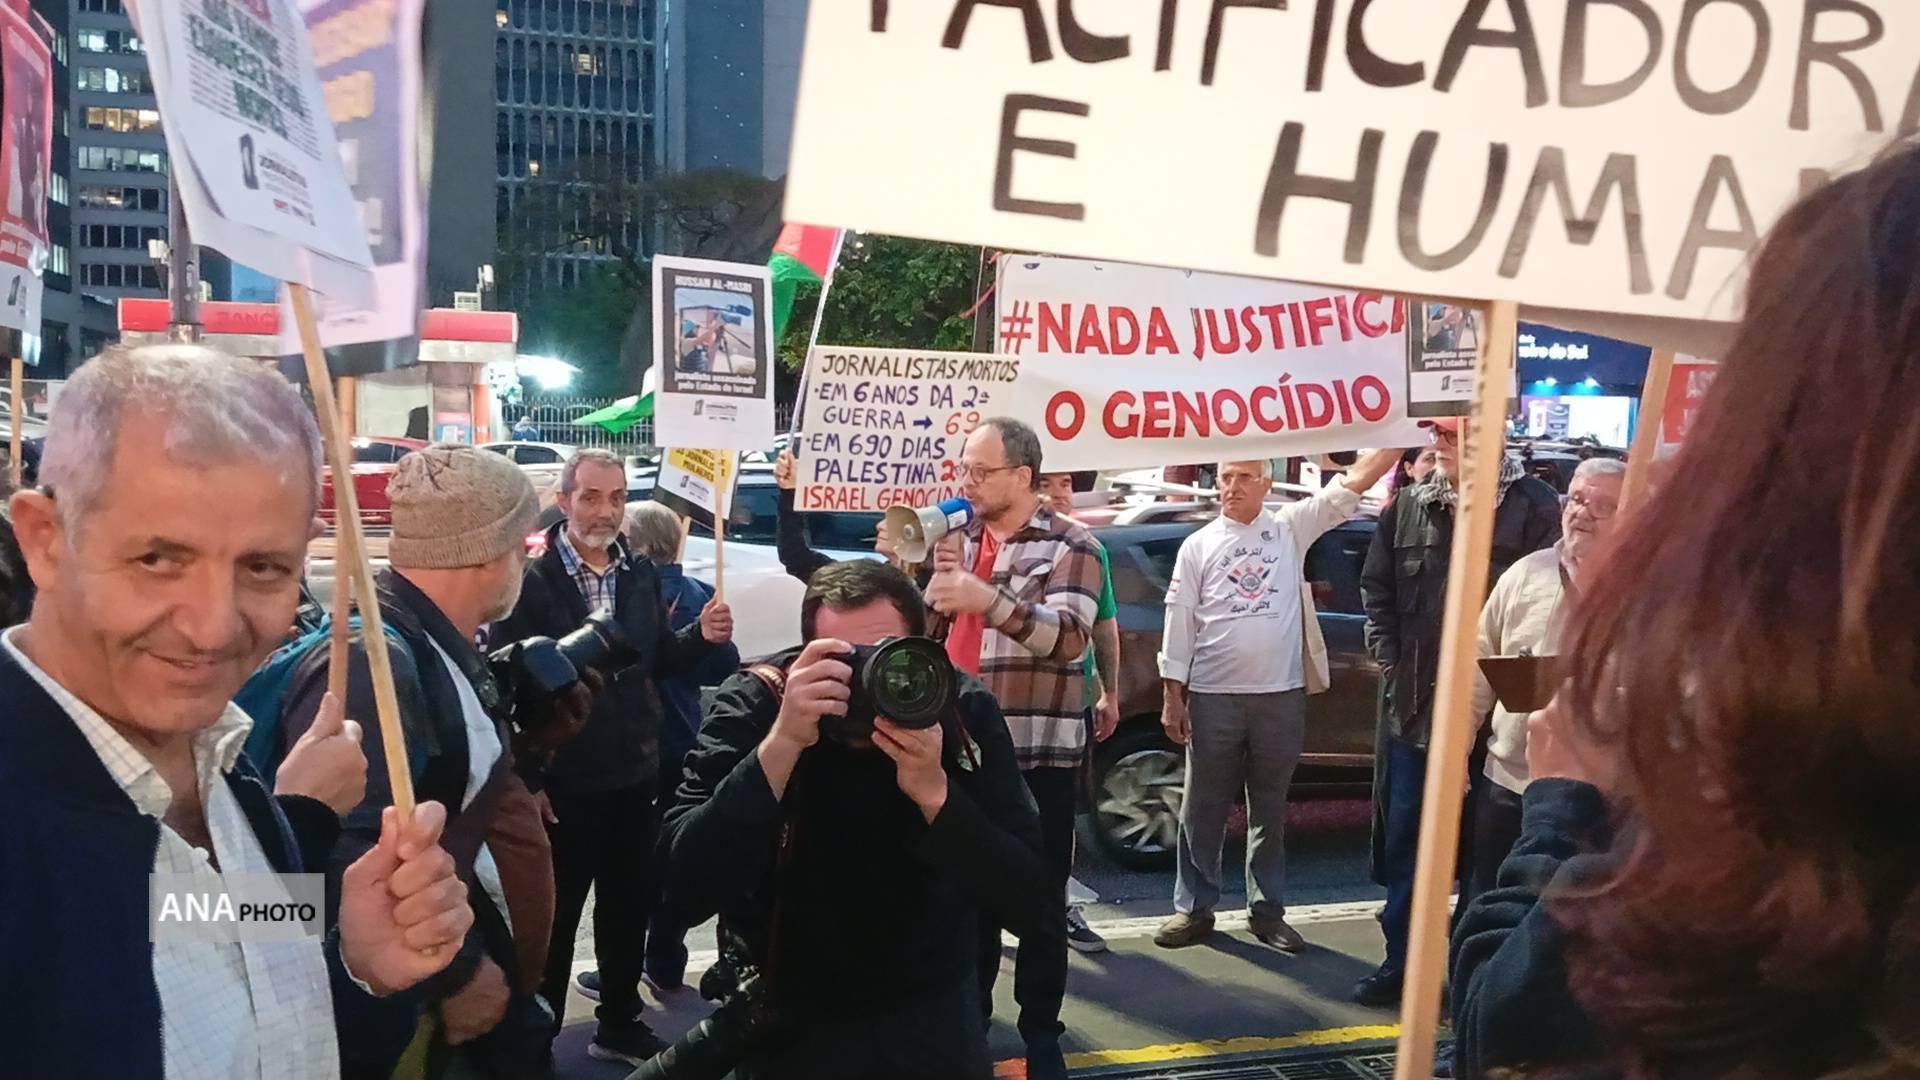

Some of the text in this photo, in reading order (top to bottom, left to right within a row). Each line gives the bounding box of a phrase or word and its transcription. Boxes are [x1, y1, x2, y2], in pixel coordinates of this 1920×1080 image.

[871, 0, 1920, 133] ACIFICADOR
[993, 93, 1829, 300] E HUMA
[1000, 299, 1180, 356] #NADA
[822, 354, 1020, 382] JORNALISTAS MORTOS
[853, 381, 870, 403] 6
[871, 385, 919, 406] ANOS
[930, 384, 953, 409] DA
[1045, 373, 1391, 442] O GENOCÍDIO
[823, 405, 906, 430] GUERRA
[848, 434, 892, 459] 690
[901, 437, 945, 460] DIAS
[814, 459, 936, 485] PALESTINA
[803, 486, 871, 510] ISRAEL
